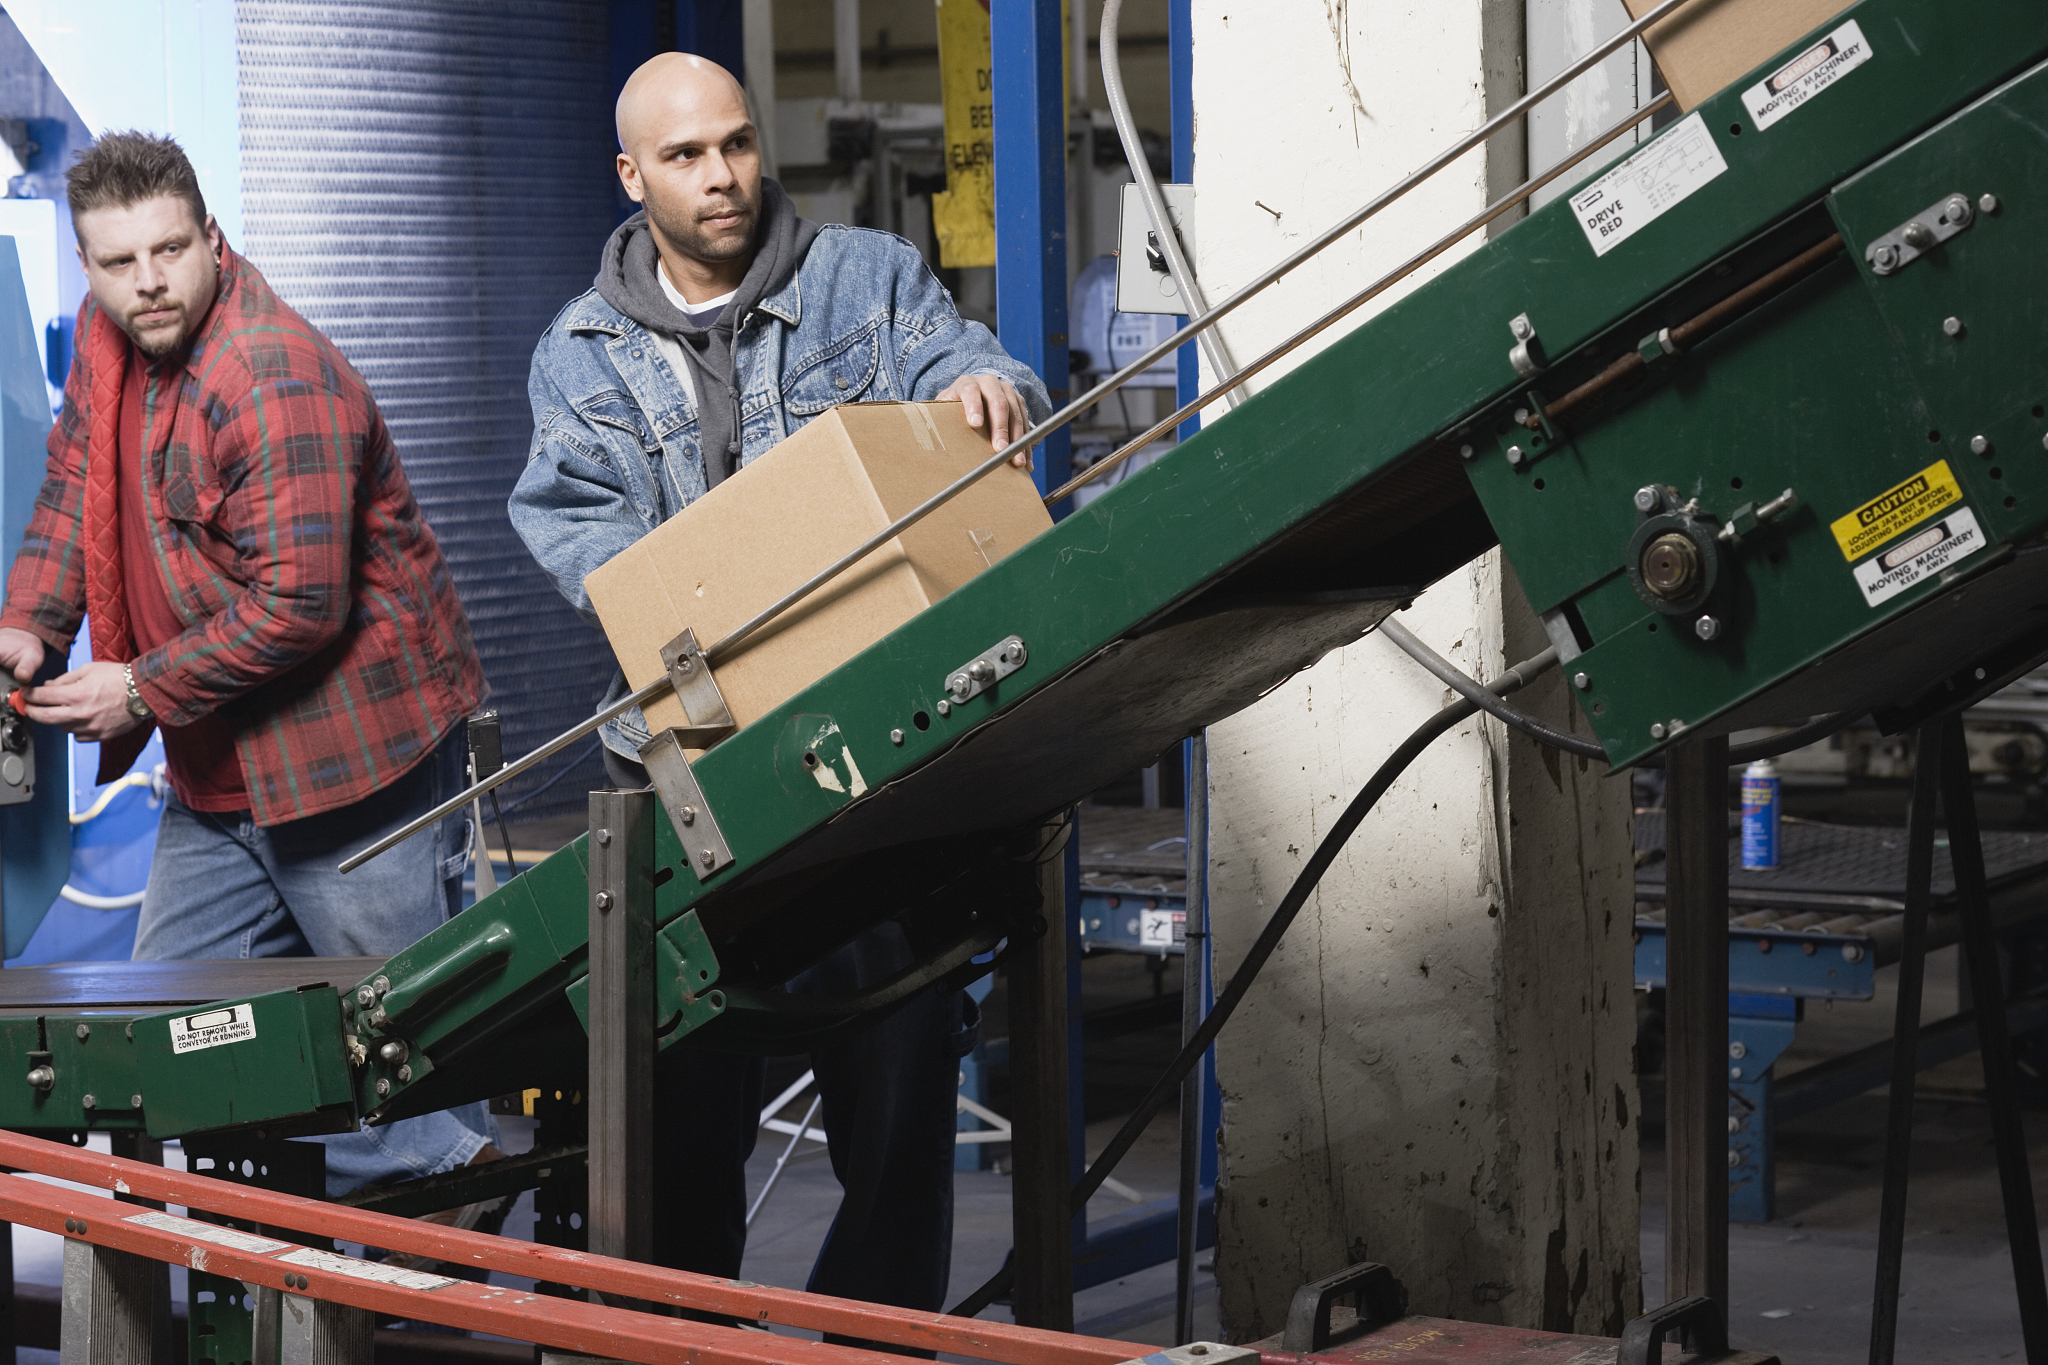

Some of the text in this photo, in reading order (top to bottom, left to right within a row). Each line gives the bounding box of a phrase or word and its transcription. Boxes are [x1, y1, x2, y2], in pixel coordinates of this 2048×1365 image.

[1757, 42, 1861, 118] MOVING MACHINERY
[1788, 70, 1838, 107] KEEP AWAY
[1572, 187, 1593, 203] PRODUCT
[1587, 199, 1624, 230] DRIVE
[1600, 216, 1623, 237] BED
[1848, 524, 1879, 546] LOOSEN
[1881, 514, 1898, 527] JAM
[1900, 504, 1917, 517] NUT
[1919, 485, 1946, 505] BEFORE
[1862, 480, 1925, 523] CAUTION
[1850, 527, 1892, 555] ADJUSTING
[1928, 491, 1953, 510] SCREW
[1868, 529, 1974, 594] MOVING MACHINERY
[1900, 555, 1950, 586] KEEP AWAY
[178, 1037, 211, 1049] CONVEYOR
[220, 1029, 250, 1041] RUNNING
[187, 1031, 200, 1040] NOT
[202, 1026, 227, 1037] REMOVE
[229, 1021, 249, 1031] WHILE
